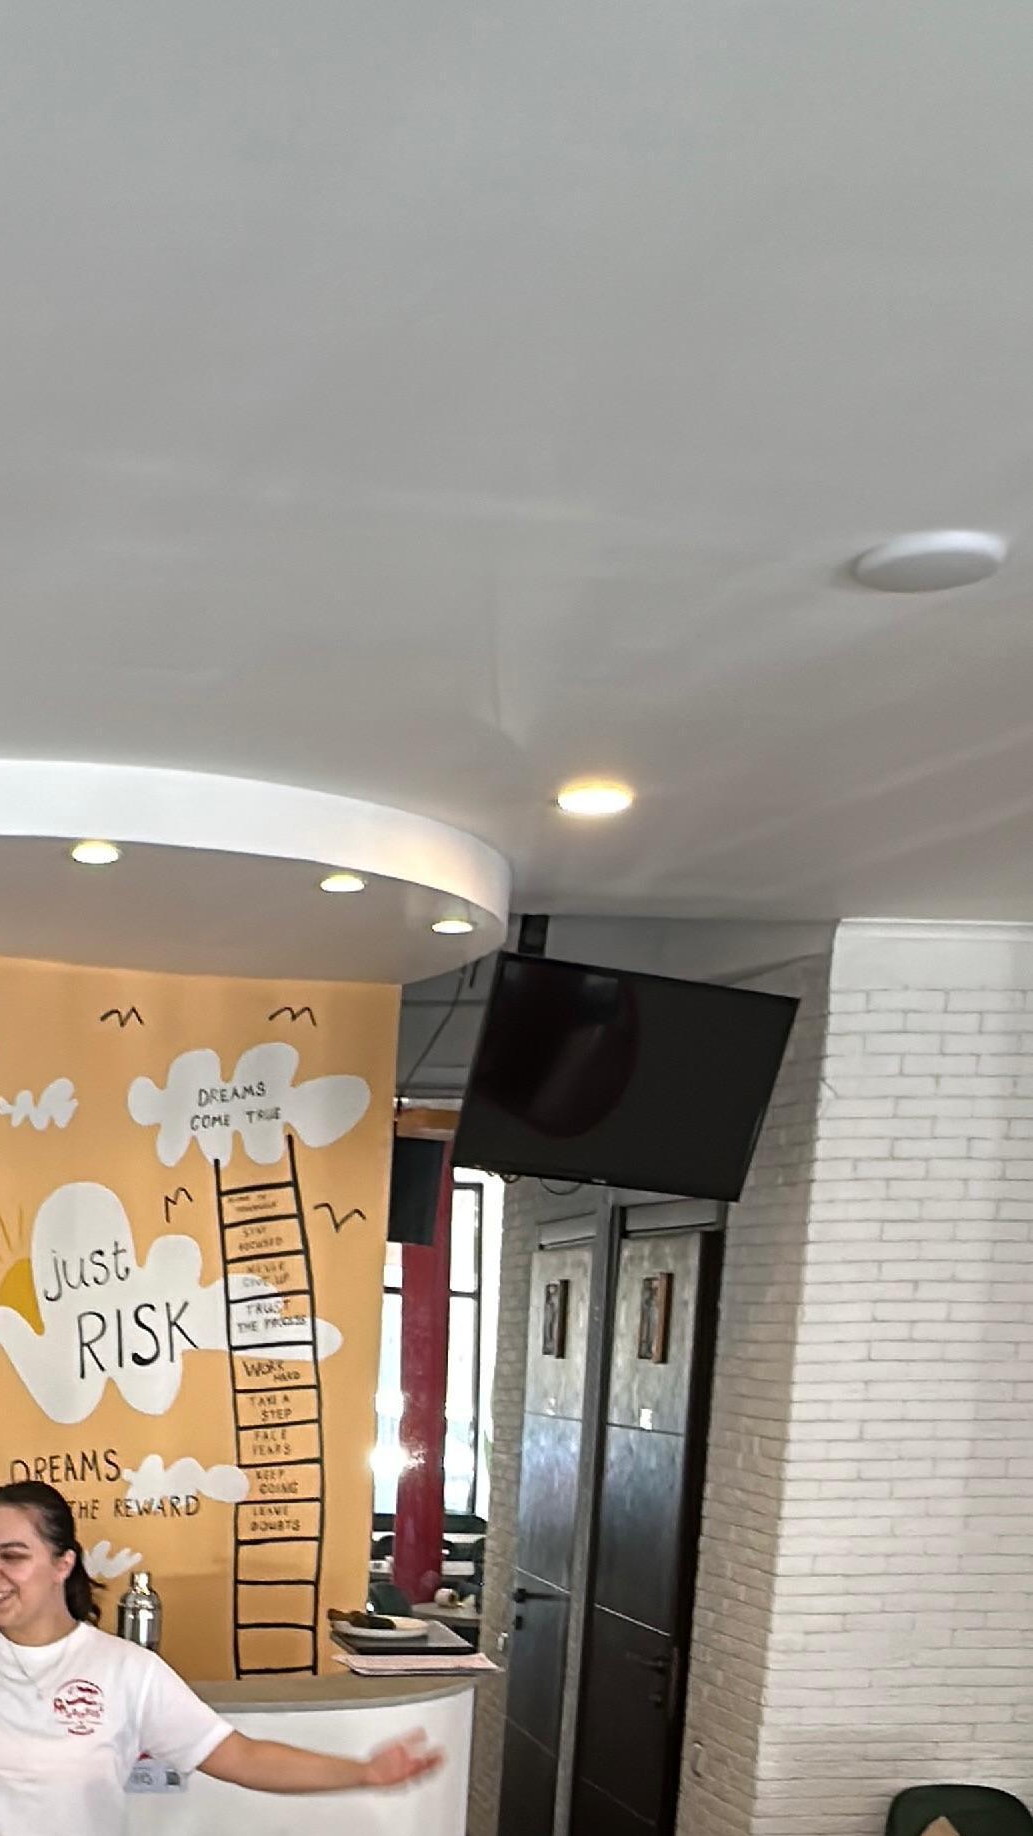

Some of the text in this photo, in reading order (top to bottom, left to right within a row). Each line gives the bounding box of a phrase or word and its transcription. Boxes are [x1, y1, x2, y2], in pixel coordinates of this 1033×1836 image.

[198, 1081, 266, 1107] DREAMS
[190, 1107, 281, 1131] COME TRUE
[44, 1240, 130, 1301] just
[77, 1301, 199, 1379] RISK
[242, 1360, 285, 1377] WORK
[282, 1394, 290, 1403] A
[261, 1408, 292, 1421] STEP
[10, 1449, 121, 1483] DREAMS
[259, 1482, 299, 1495] GOING
[67, 1495, 200, 1520] THE REWARD
